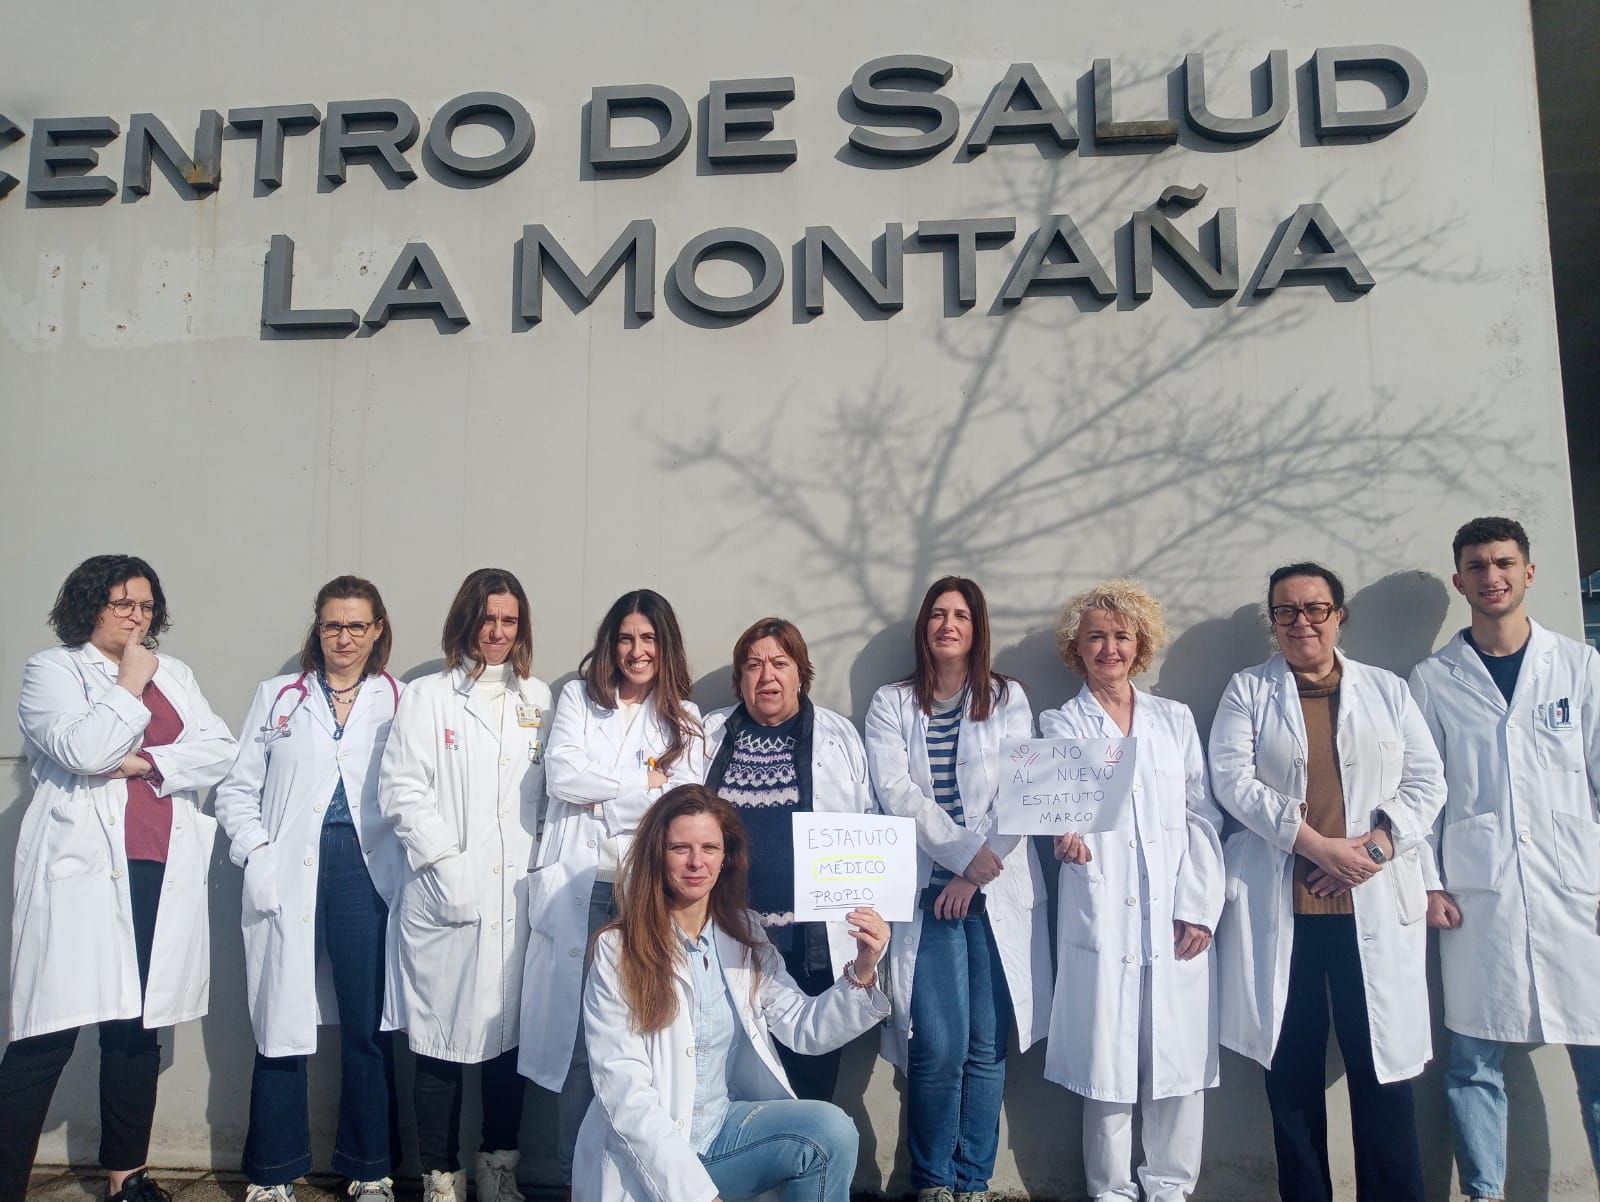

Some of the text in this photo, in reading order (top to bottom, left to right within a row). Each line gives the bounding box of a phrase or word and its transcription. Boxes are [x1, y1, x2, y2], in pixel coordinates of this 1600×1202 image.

[0, 44, 1430, 201] ENTRO DE SALUD
[264, 182, 1377, 331] LA MONTAÑA
[1052, 745, 1082, 760] NO
[1012, 764, 1114, 785] AL NUEVO
[1022, 789, 1105, 806] ESTATUTO
[1039, 812, 1093, 824] MARCO
[807, 827, 898, 850] ESTATUTO
[819, 859, 886, 875] MÉDICO
[809, 887, 874, 905] PROPIO
